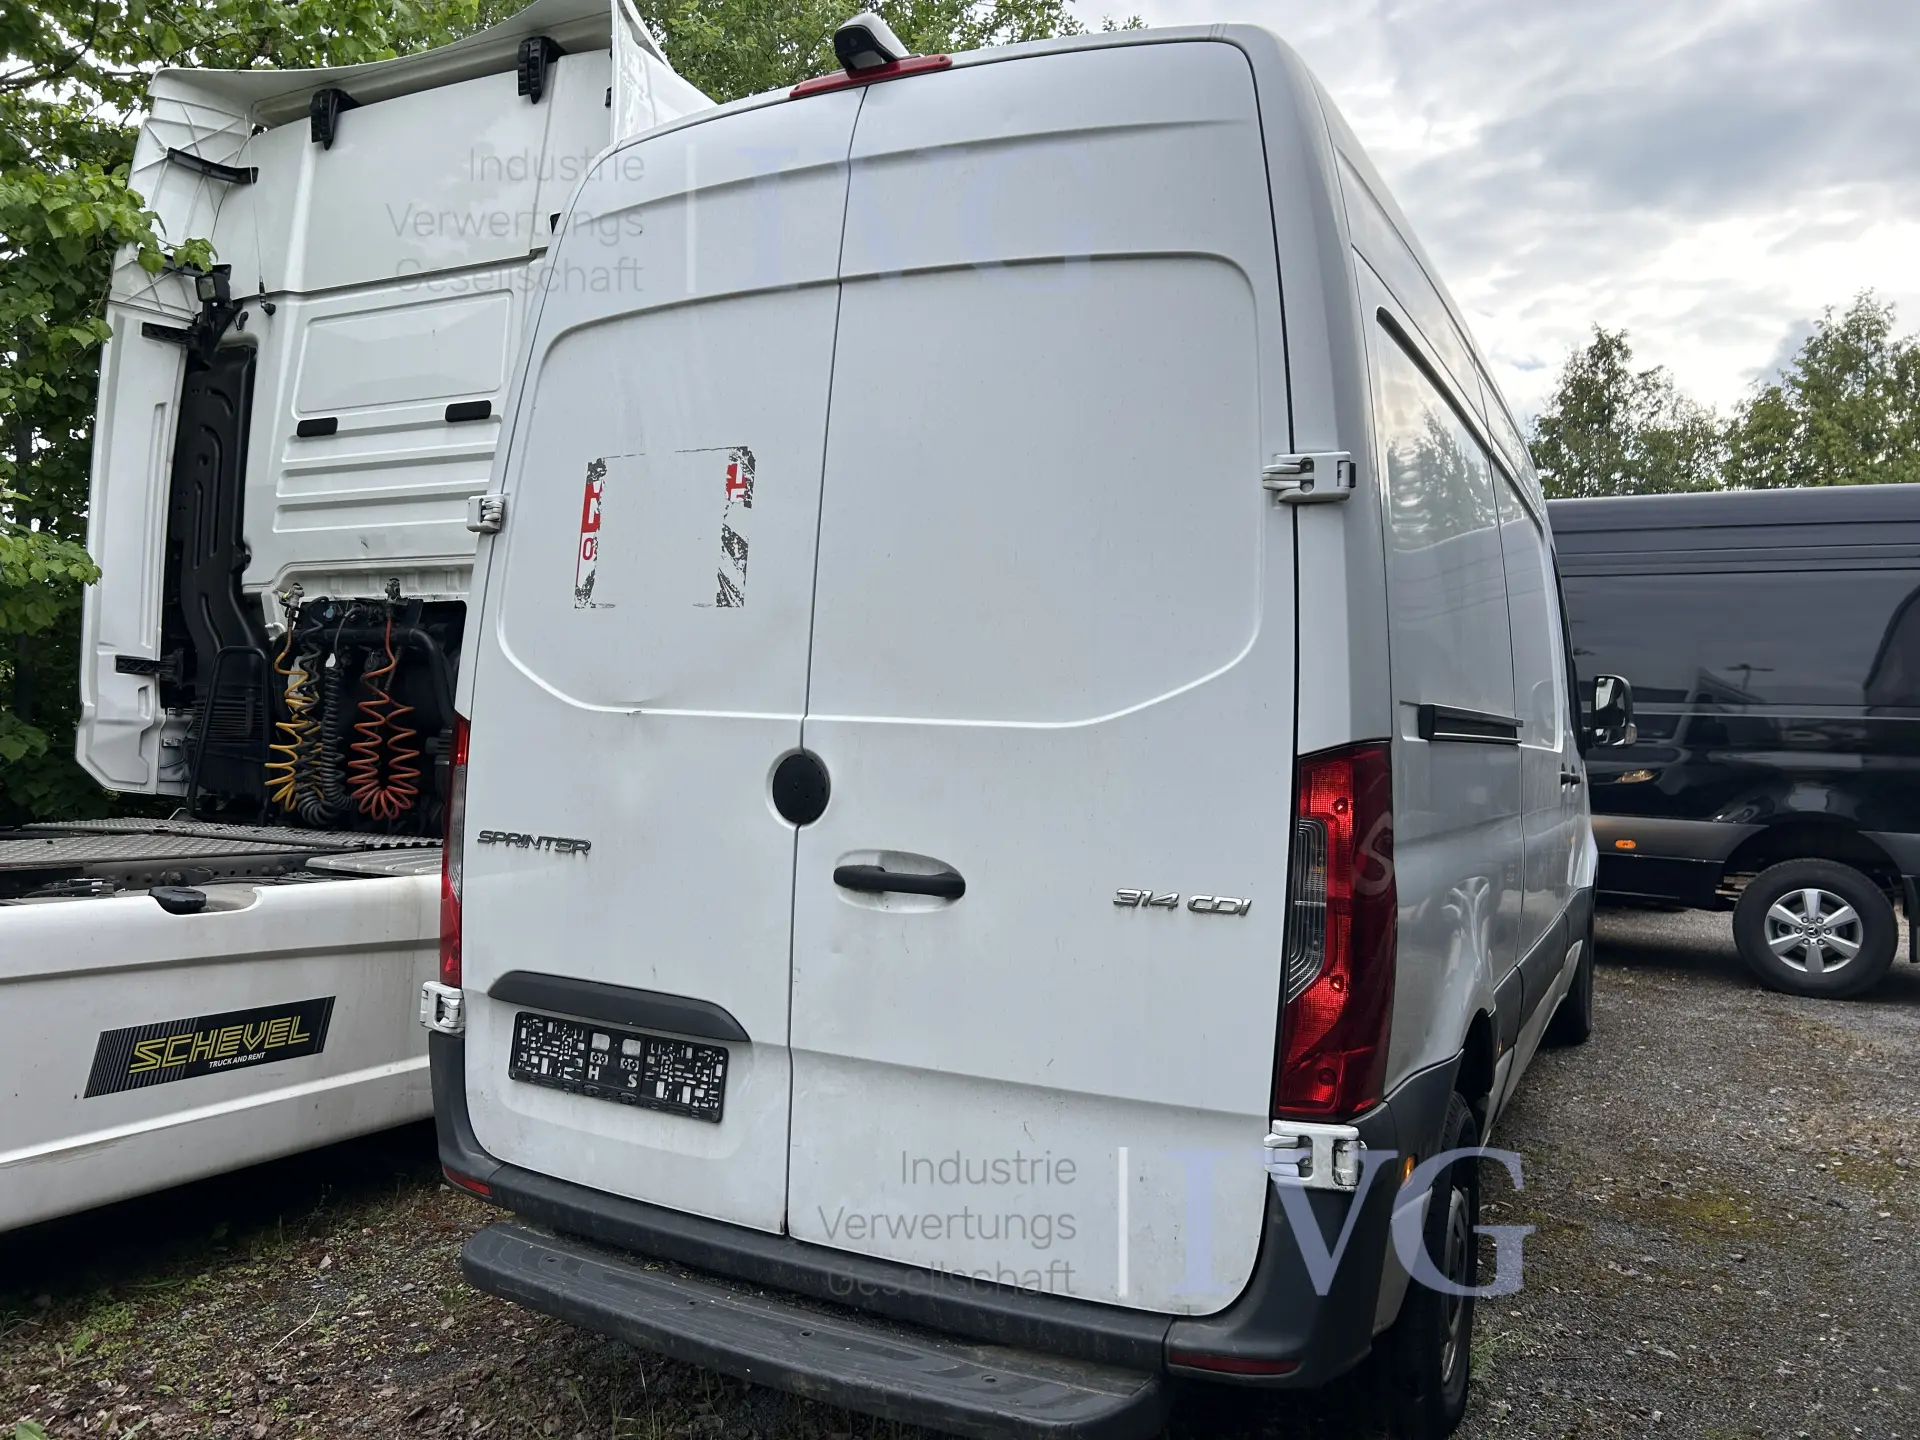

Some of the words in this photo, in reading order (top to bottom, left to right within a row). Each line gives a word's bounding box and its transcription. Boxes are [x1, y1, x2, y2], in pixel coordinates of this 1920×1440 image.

[477, 830, 591, 855] SPRINTER
[1113, 888, 1179, 911] 314
[1187, 894, 1251, 916] CDI
[128, 1015, 310, 1074] SCHEVEL
[209, 1058, 233, 1068] TRUCK
[232, 1055, 248, 1064] AND
[247, 1051, 266, 1061] RENT
